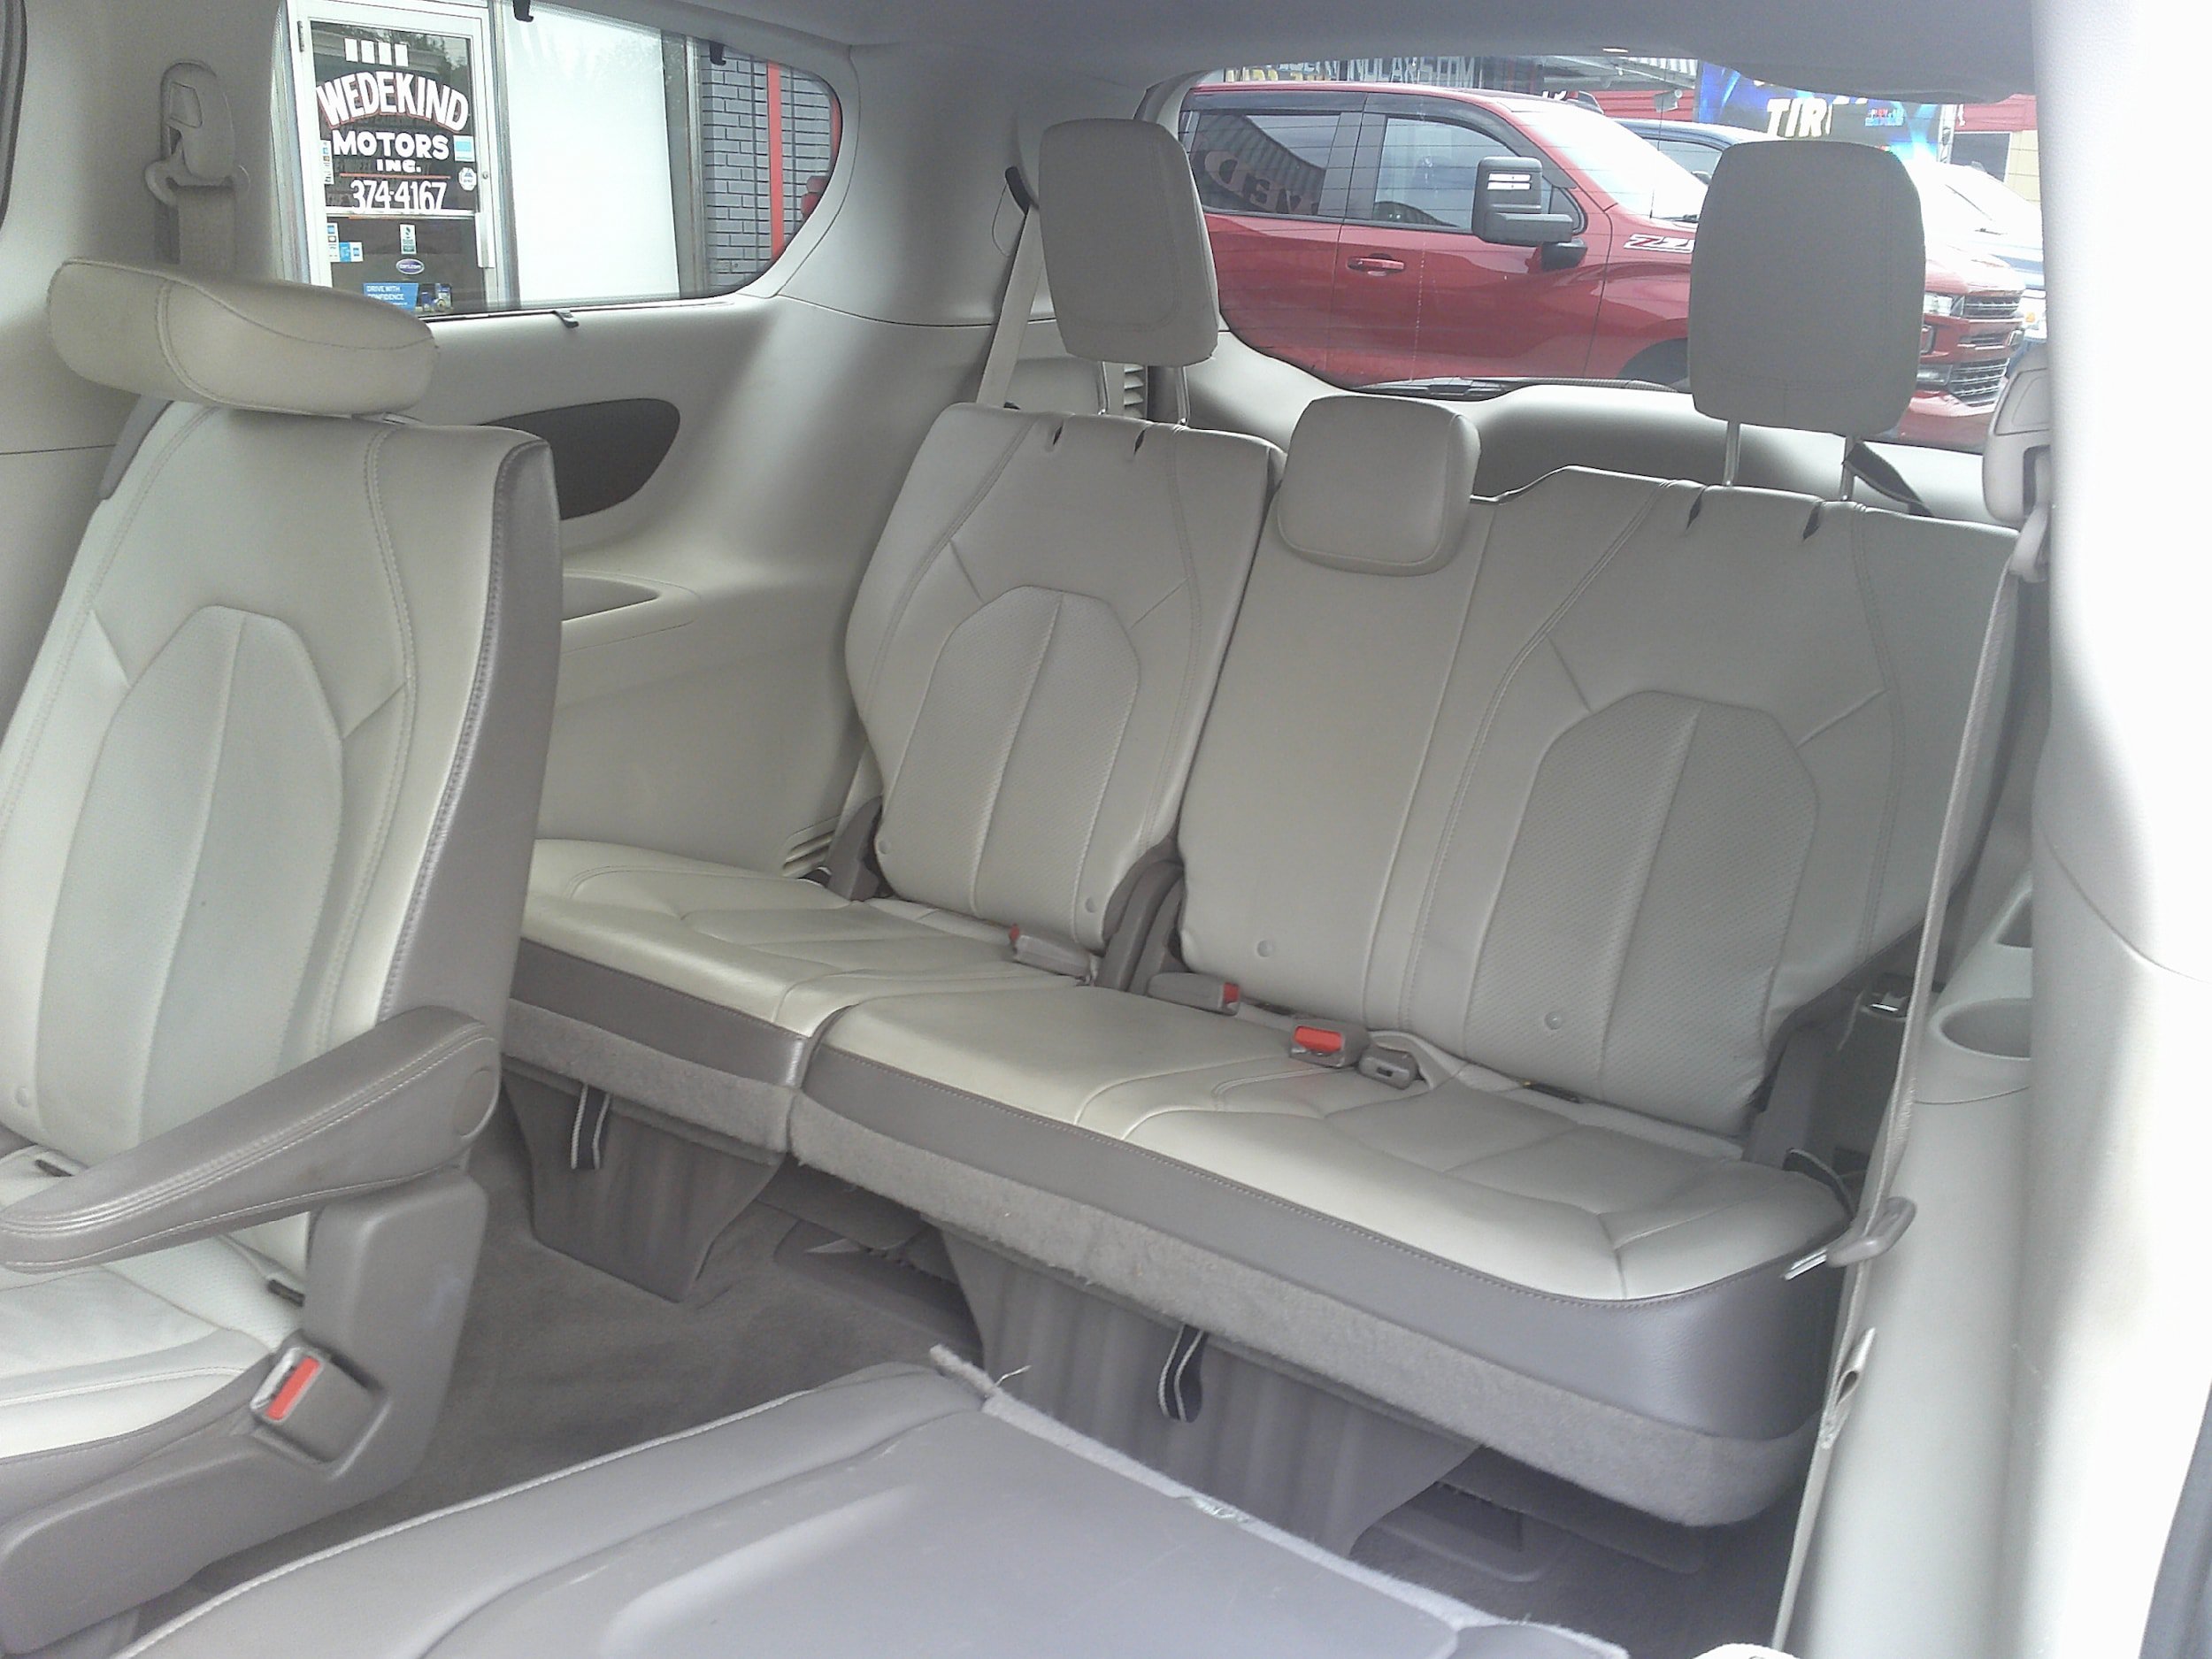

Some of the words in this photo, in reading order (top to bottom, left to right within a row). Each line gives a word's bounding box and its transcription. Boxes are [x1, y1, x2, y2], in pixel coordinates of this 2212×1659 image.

[316, 70, 469, 132] WEDEKIND
[332, 129, 449, 160] MOTORS
[377, 158, 422, 173] INC.
[350, 178, 447, 214] 374-4167
